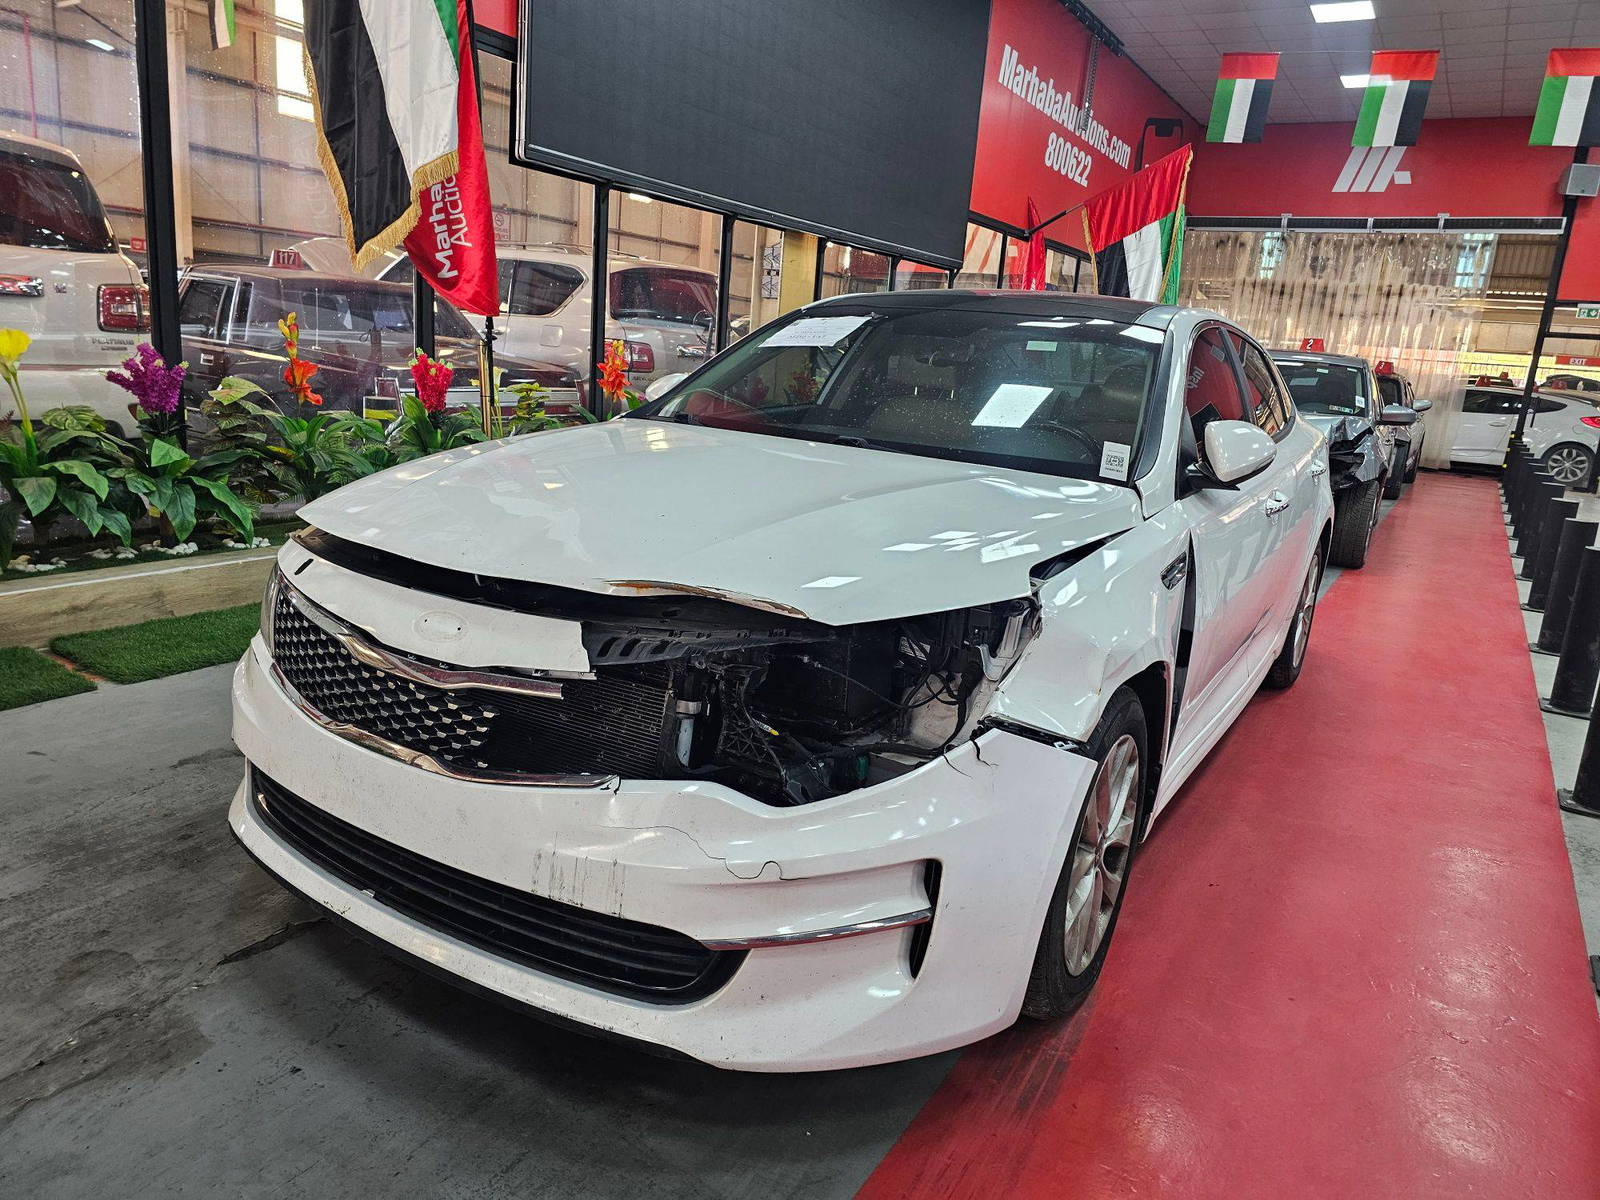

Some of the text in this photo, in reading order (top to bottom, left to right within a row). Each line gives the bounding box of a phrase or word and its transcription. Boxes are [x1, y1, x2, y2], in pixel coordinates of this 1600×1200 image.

[1044, 132, 1093, 187] 800622
[444, 175, 472, 248] Auctio
[429, 184, 458, 279] Marha
[278, 251, 296, 265] 117
[1306, 339, 1314, 349] 2
[1569, 358, 1587, 366] EXIT
